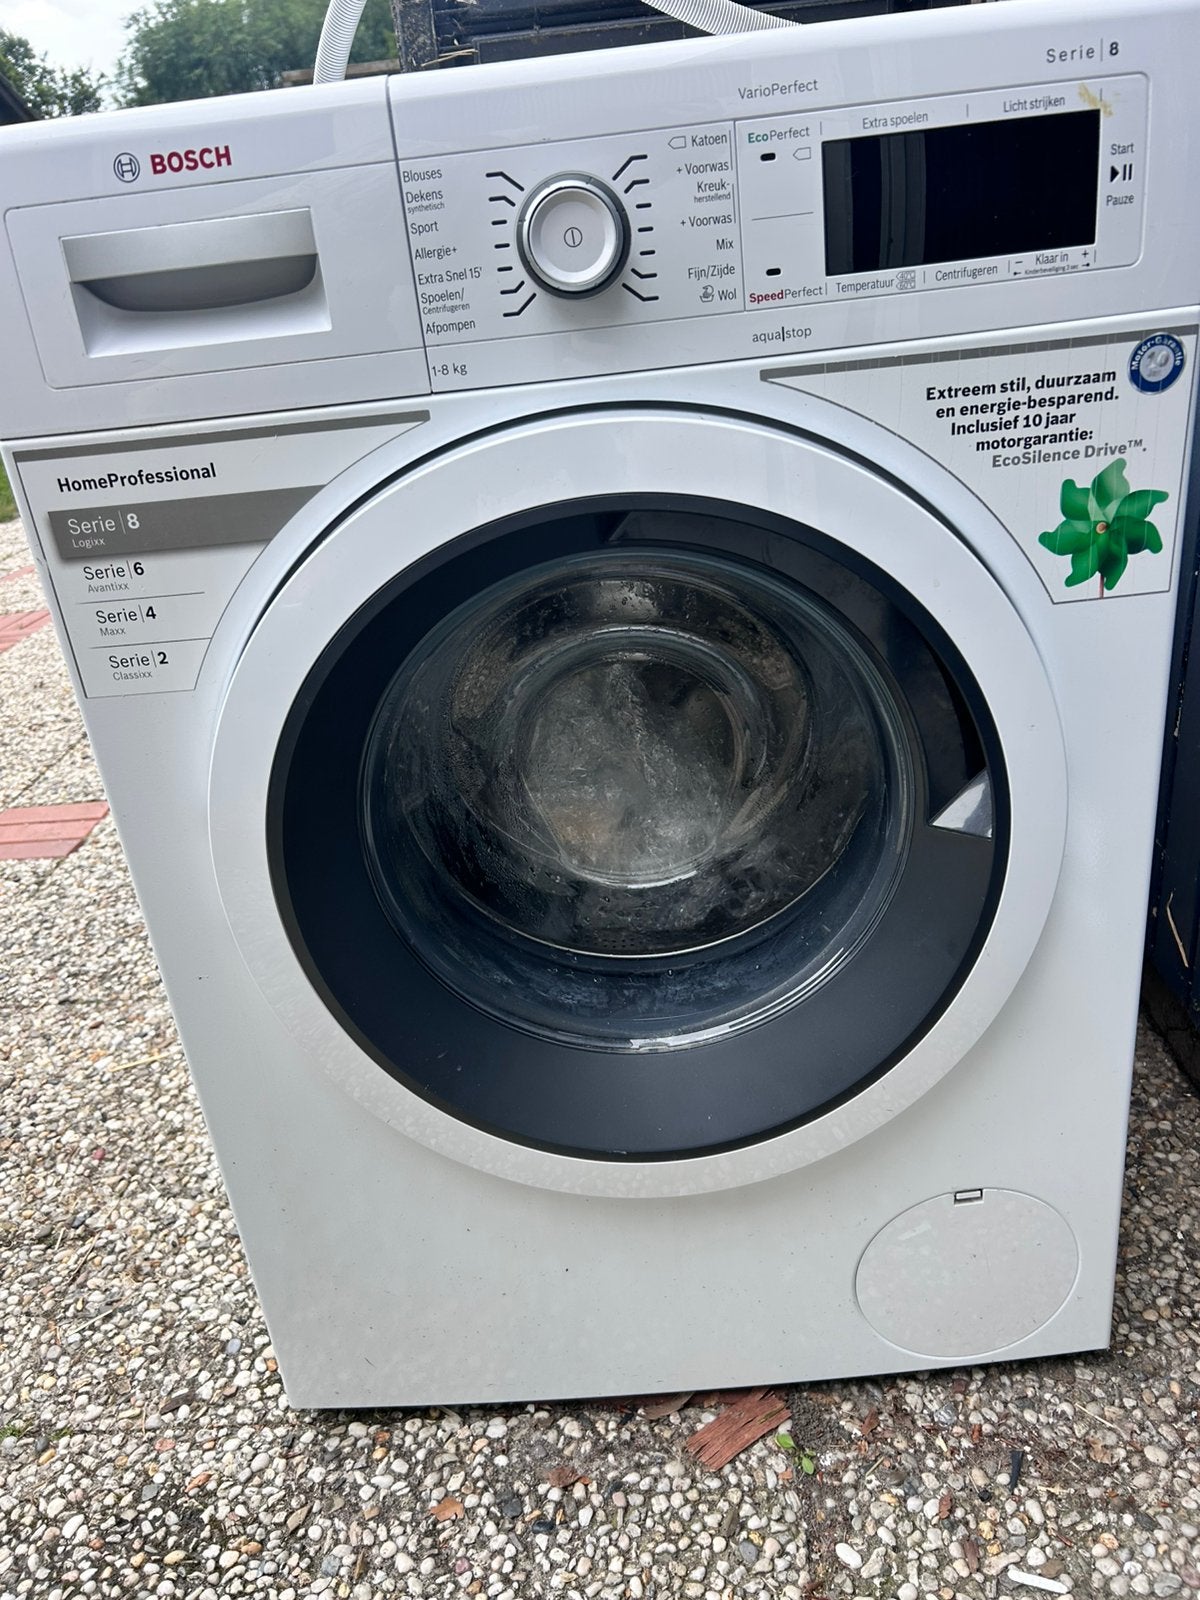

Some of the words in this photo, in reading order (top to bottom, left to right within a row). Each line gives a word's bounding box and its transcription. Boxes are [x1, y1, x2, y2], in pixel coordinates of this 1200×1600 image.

[1046, 44, 1095, 64] Serie
[1109, 41, 1119, 56] 8
[738, 79, 819, 100] VarioPerfect
[1003, 98, 1028, 112] Licht
[1029, 95, 1065, 110] strijken
[862, 116, 888, 130] Extra
[890, 111, 928, 128] spoelen
[691, 133, 727, 147] Katoen
[748, 126, 810, 144] EcoPerfect
[1110, 142, 1134, 155] Start
[150, 145, 232, 175] BOSCH
[685, 161, 729, 175] Voorwas
[402, 168, 443, 183] Blouses
[697, 178, 730, 193] Kreuk-
[405, 188, 444, 204] Dekens
[693, 191, 731, 203] herstellend
[1106, 194, 1134, 206] Pauze
[407, 201, 445, 214] synthetisch
[410, 220, 439, 237] Sport
[688, 213, 733, 227] Voorwas
[716, 238, 734, 250] Mix
[414, 245, 457, 261] Allergie+
[1035, 253, 1059, 265] Klaar
[1060, 251, 1069, 262] in
[418, 272, 444, 286] Extra
[445, 268, 467, 282] Snel
[468, 266, 483, 279] 15'
[688, 263, 736, 281] Fijn/Zijde
[935, 263, 998, 281] Centrifugeren
[718, 288, 737, 300] Wol
[836, 277, 894, 294] Temperatuur
[420, 287, 465, 305] Spoelen/
[749, 286, 823, 304] SpeedPerfect
[422, 302, 470, 315] Centrifugeren
[425, 318, 476, 335] Afpompen
[431, 363, 449, 377] 1-8
[453, 363, 468, 378] kg
[926, 384, 996, 401] Extreem
[1000, 377, 1031, 394] stil,
[1035, 371, 1116, 390] duurzaam
[936, 405, 956, 418] en
[959, 386, 1120, 415] energie-besparend.
[951, 414, 1020, 436] Inclusief
[1022, 413, 1042, 429] 10
[1044, 410, 1076, 430] jaar
[976, 428, 1094, 453] motorgarantie:
[991, 449, 1080, 468] EcoSilence
[57, 462, 217, 493] HomeProfessional
[67, 515, 116, 535] Serie
[126, 512, 140, 529] 8
[71, 537, 105, 549] Logixx
[83, 563, 126, 580] Serie
[133, 561, 145, 576] 6
[87, 581, 130, 594] Avantixx
[95, 607, 138, 624] Serie
[145, 606, 157, 620] 4
[99, 626, 126, 637] Maxx
[108, 652, 150, 669] Serie
[157, 651, 169, 665] 2
[112, 669, 152, 681] Classixx
